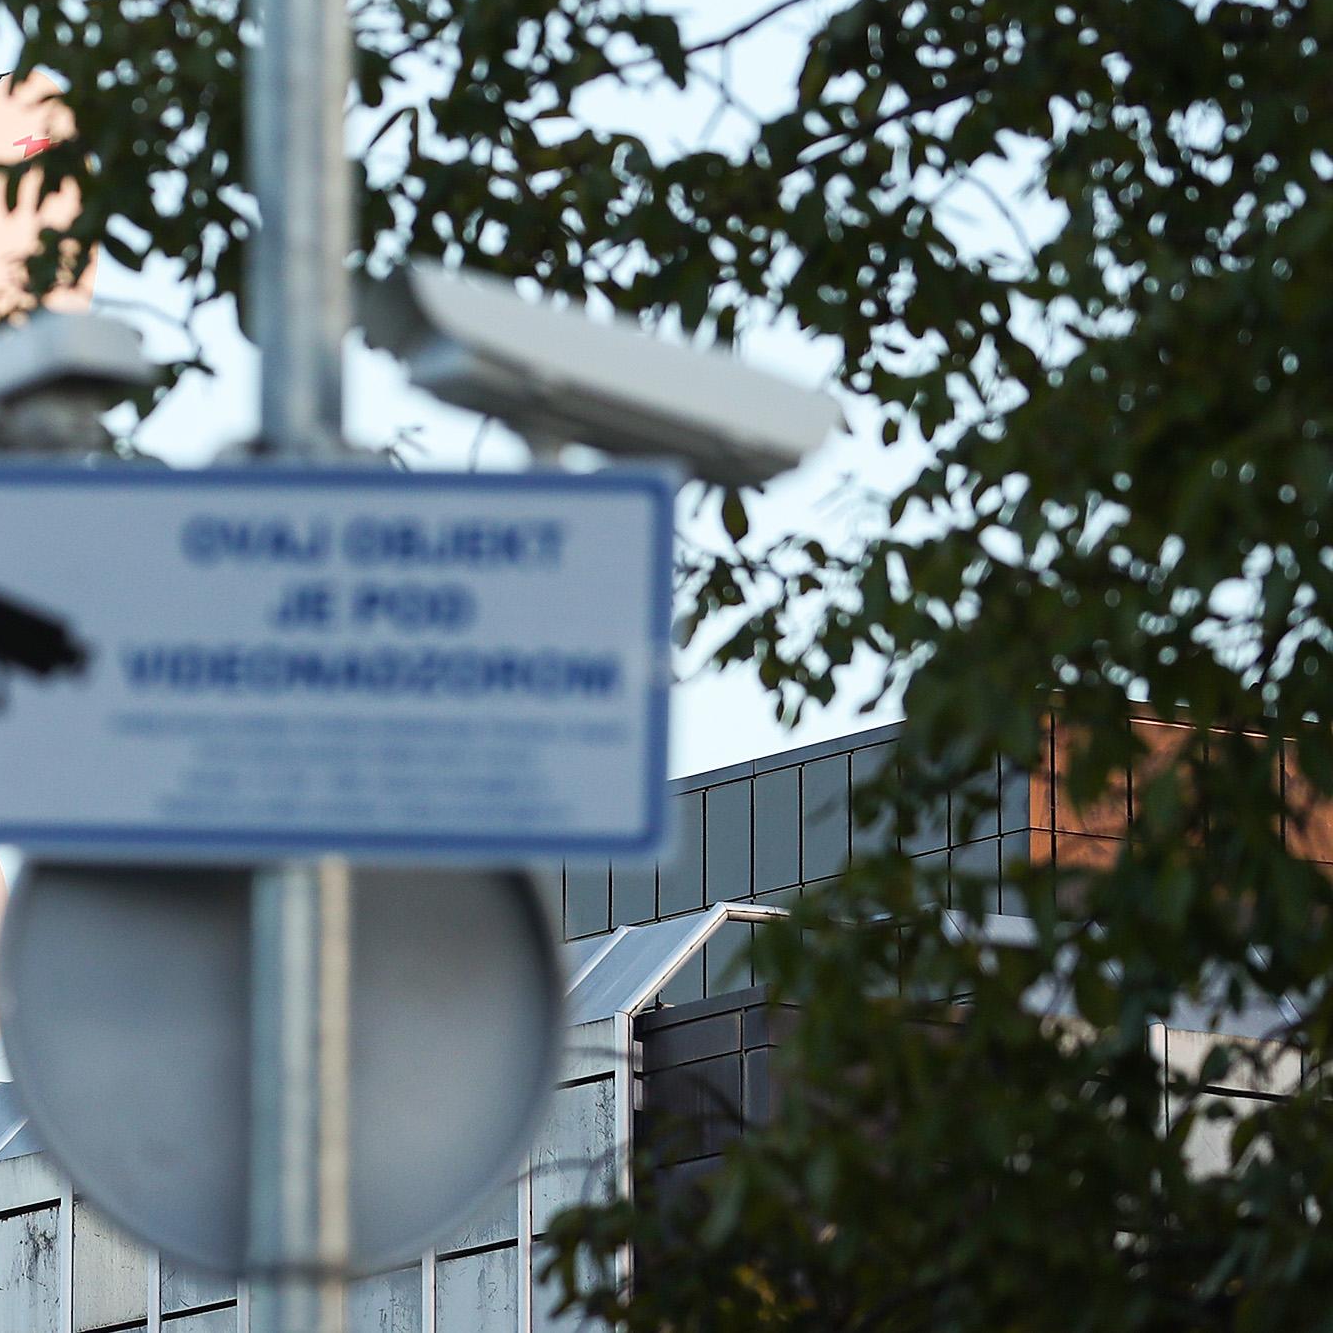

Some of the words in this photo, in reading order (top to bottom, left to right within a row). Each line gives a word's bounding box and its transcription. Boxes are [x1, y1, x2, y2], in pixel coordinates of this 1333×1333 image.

[181, 515, 331, 566] OVAJ
[343, 516, 564, 569] OBJEKT
[271, 580, 332, 630] JE
[351, 581, 476, 632] POD
